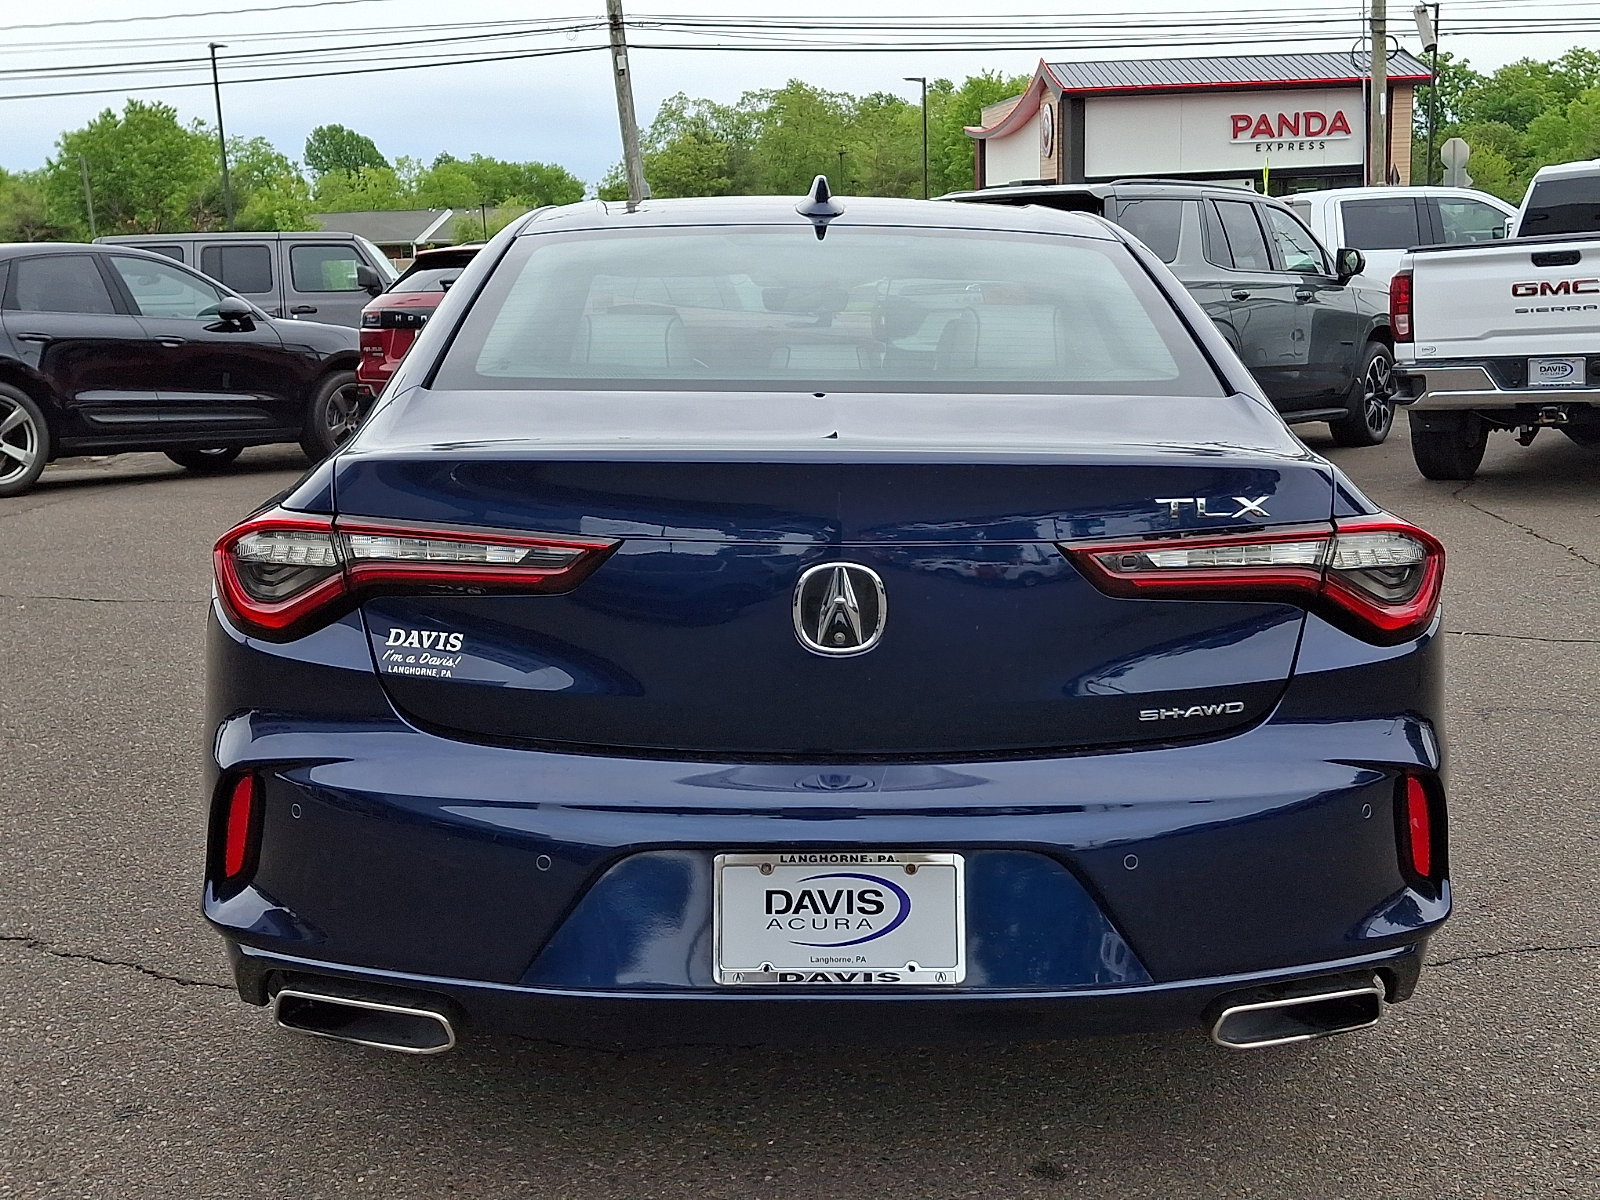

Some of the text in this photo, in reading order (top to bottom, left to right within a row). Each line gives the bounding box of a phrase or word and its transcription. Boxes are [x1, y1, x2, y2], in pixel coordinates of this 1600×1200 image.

[1230, 110, 1352, 139] PANDA
[1255, 141, 1326, 152] EXPRESS
[1511, 279, 1600, 297] GMC
[1514, 304, 1598, 314] SIERRA
[1539, 365, 1568, 373] DAVIS
[1154, 495, 1271, 519] TLX
[385, 628, 464, 652] DAVIS
[382, 649, 462, 668] I'm a Davis!
[387, 665, 452, 678] LANGHORNE, PA
[1138, 701, 1245, 721] SH-AWD
[765, 889, 885, 915] DAVIS
[766, 918, 873, 930] ACURA
[810, 955, 854, 965] Langhorne,
[778, 972, 901, 983] DAVIS
